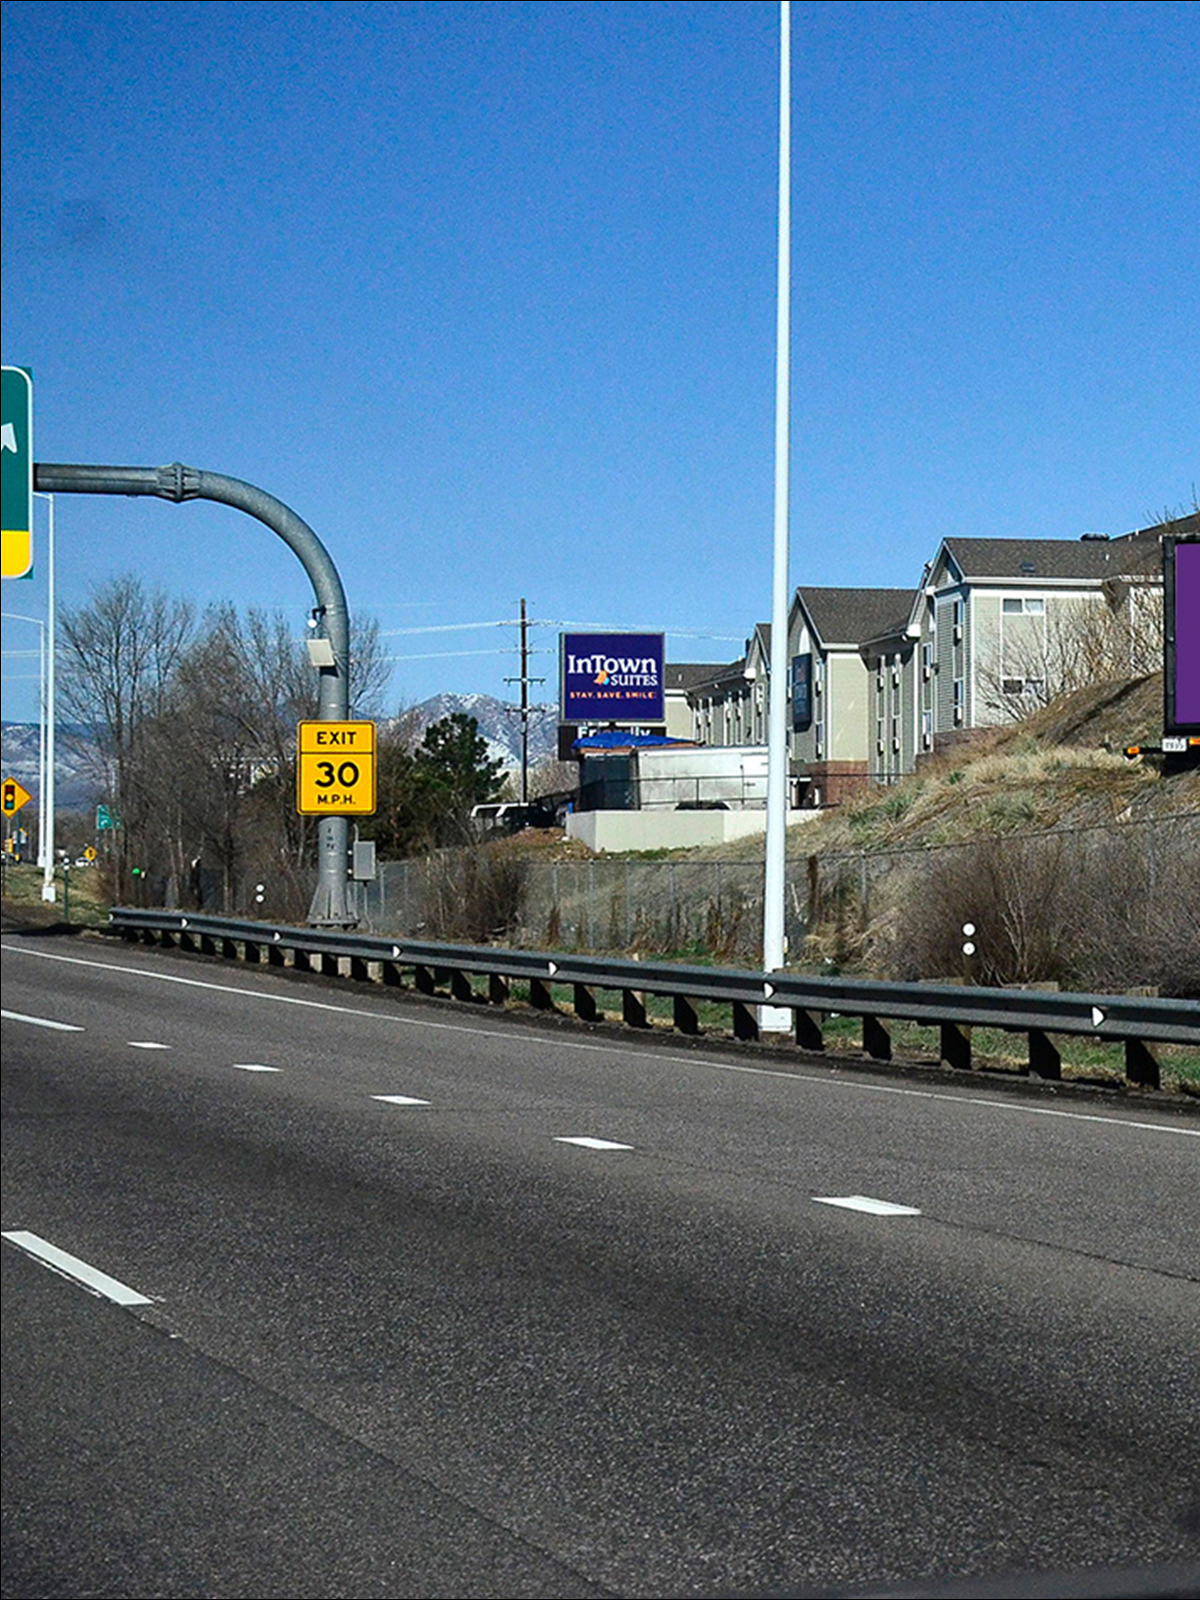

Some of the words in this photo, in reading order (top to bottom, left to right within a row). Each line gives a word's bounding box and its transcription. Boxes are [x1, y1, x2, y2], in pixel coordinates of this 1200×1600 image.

[567, 654, 658, 674] InTown
[610, 674, 658, 686] SUITES
[316, 731, 357, 745] EXIT
[315, 761, 359, 788] 30
[317, 794, 356, 805] M.P.H.
